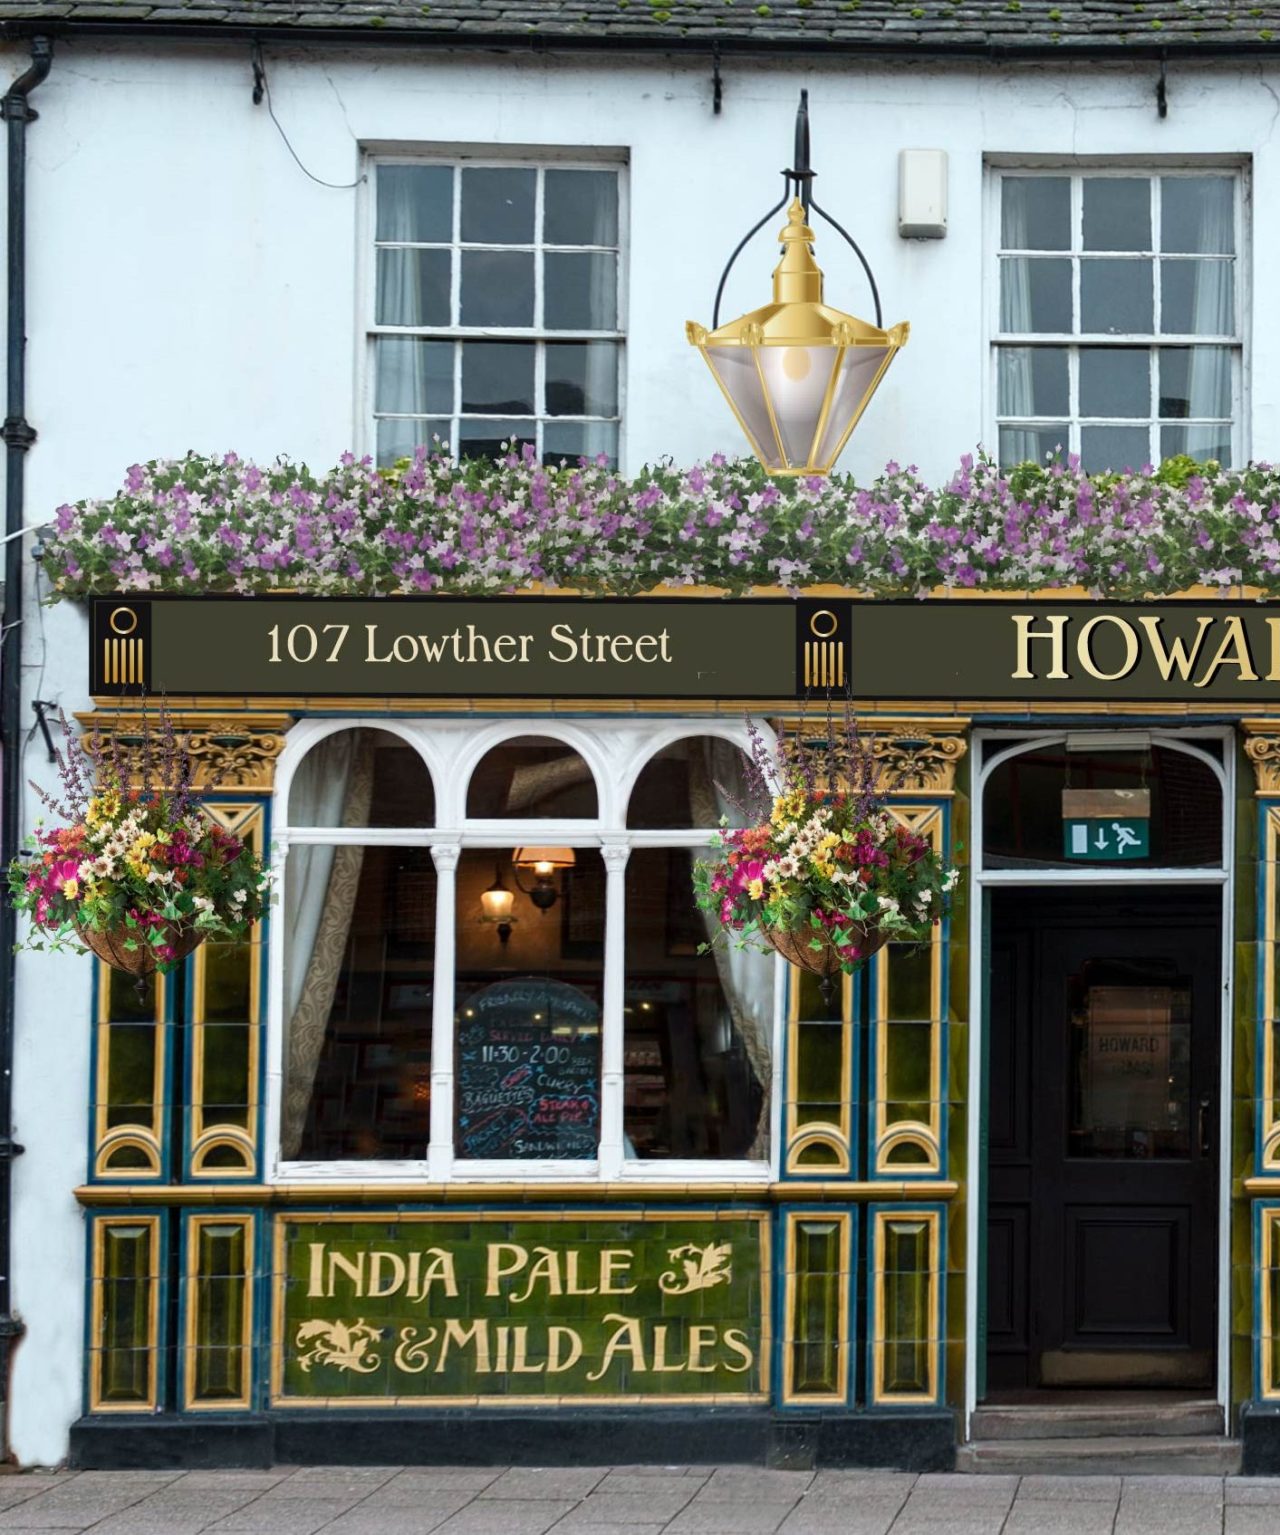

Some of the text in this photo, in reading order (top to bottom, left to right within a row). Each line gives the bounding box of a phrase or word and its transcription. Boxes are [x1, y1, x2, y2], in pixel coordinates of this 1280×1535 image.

[268, 625, 672, 662] 107 Lowther Street
[1100, 1037, 1160, 1053] HOWARD
[308, 1244, 636, 1302] INDIA PALE
[395, 1314, 752, 1380] & MILD ALES
